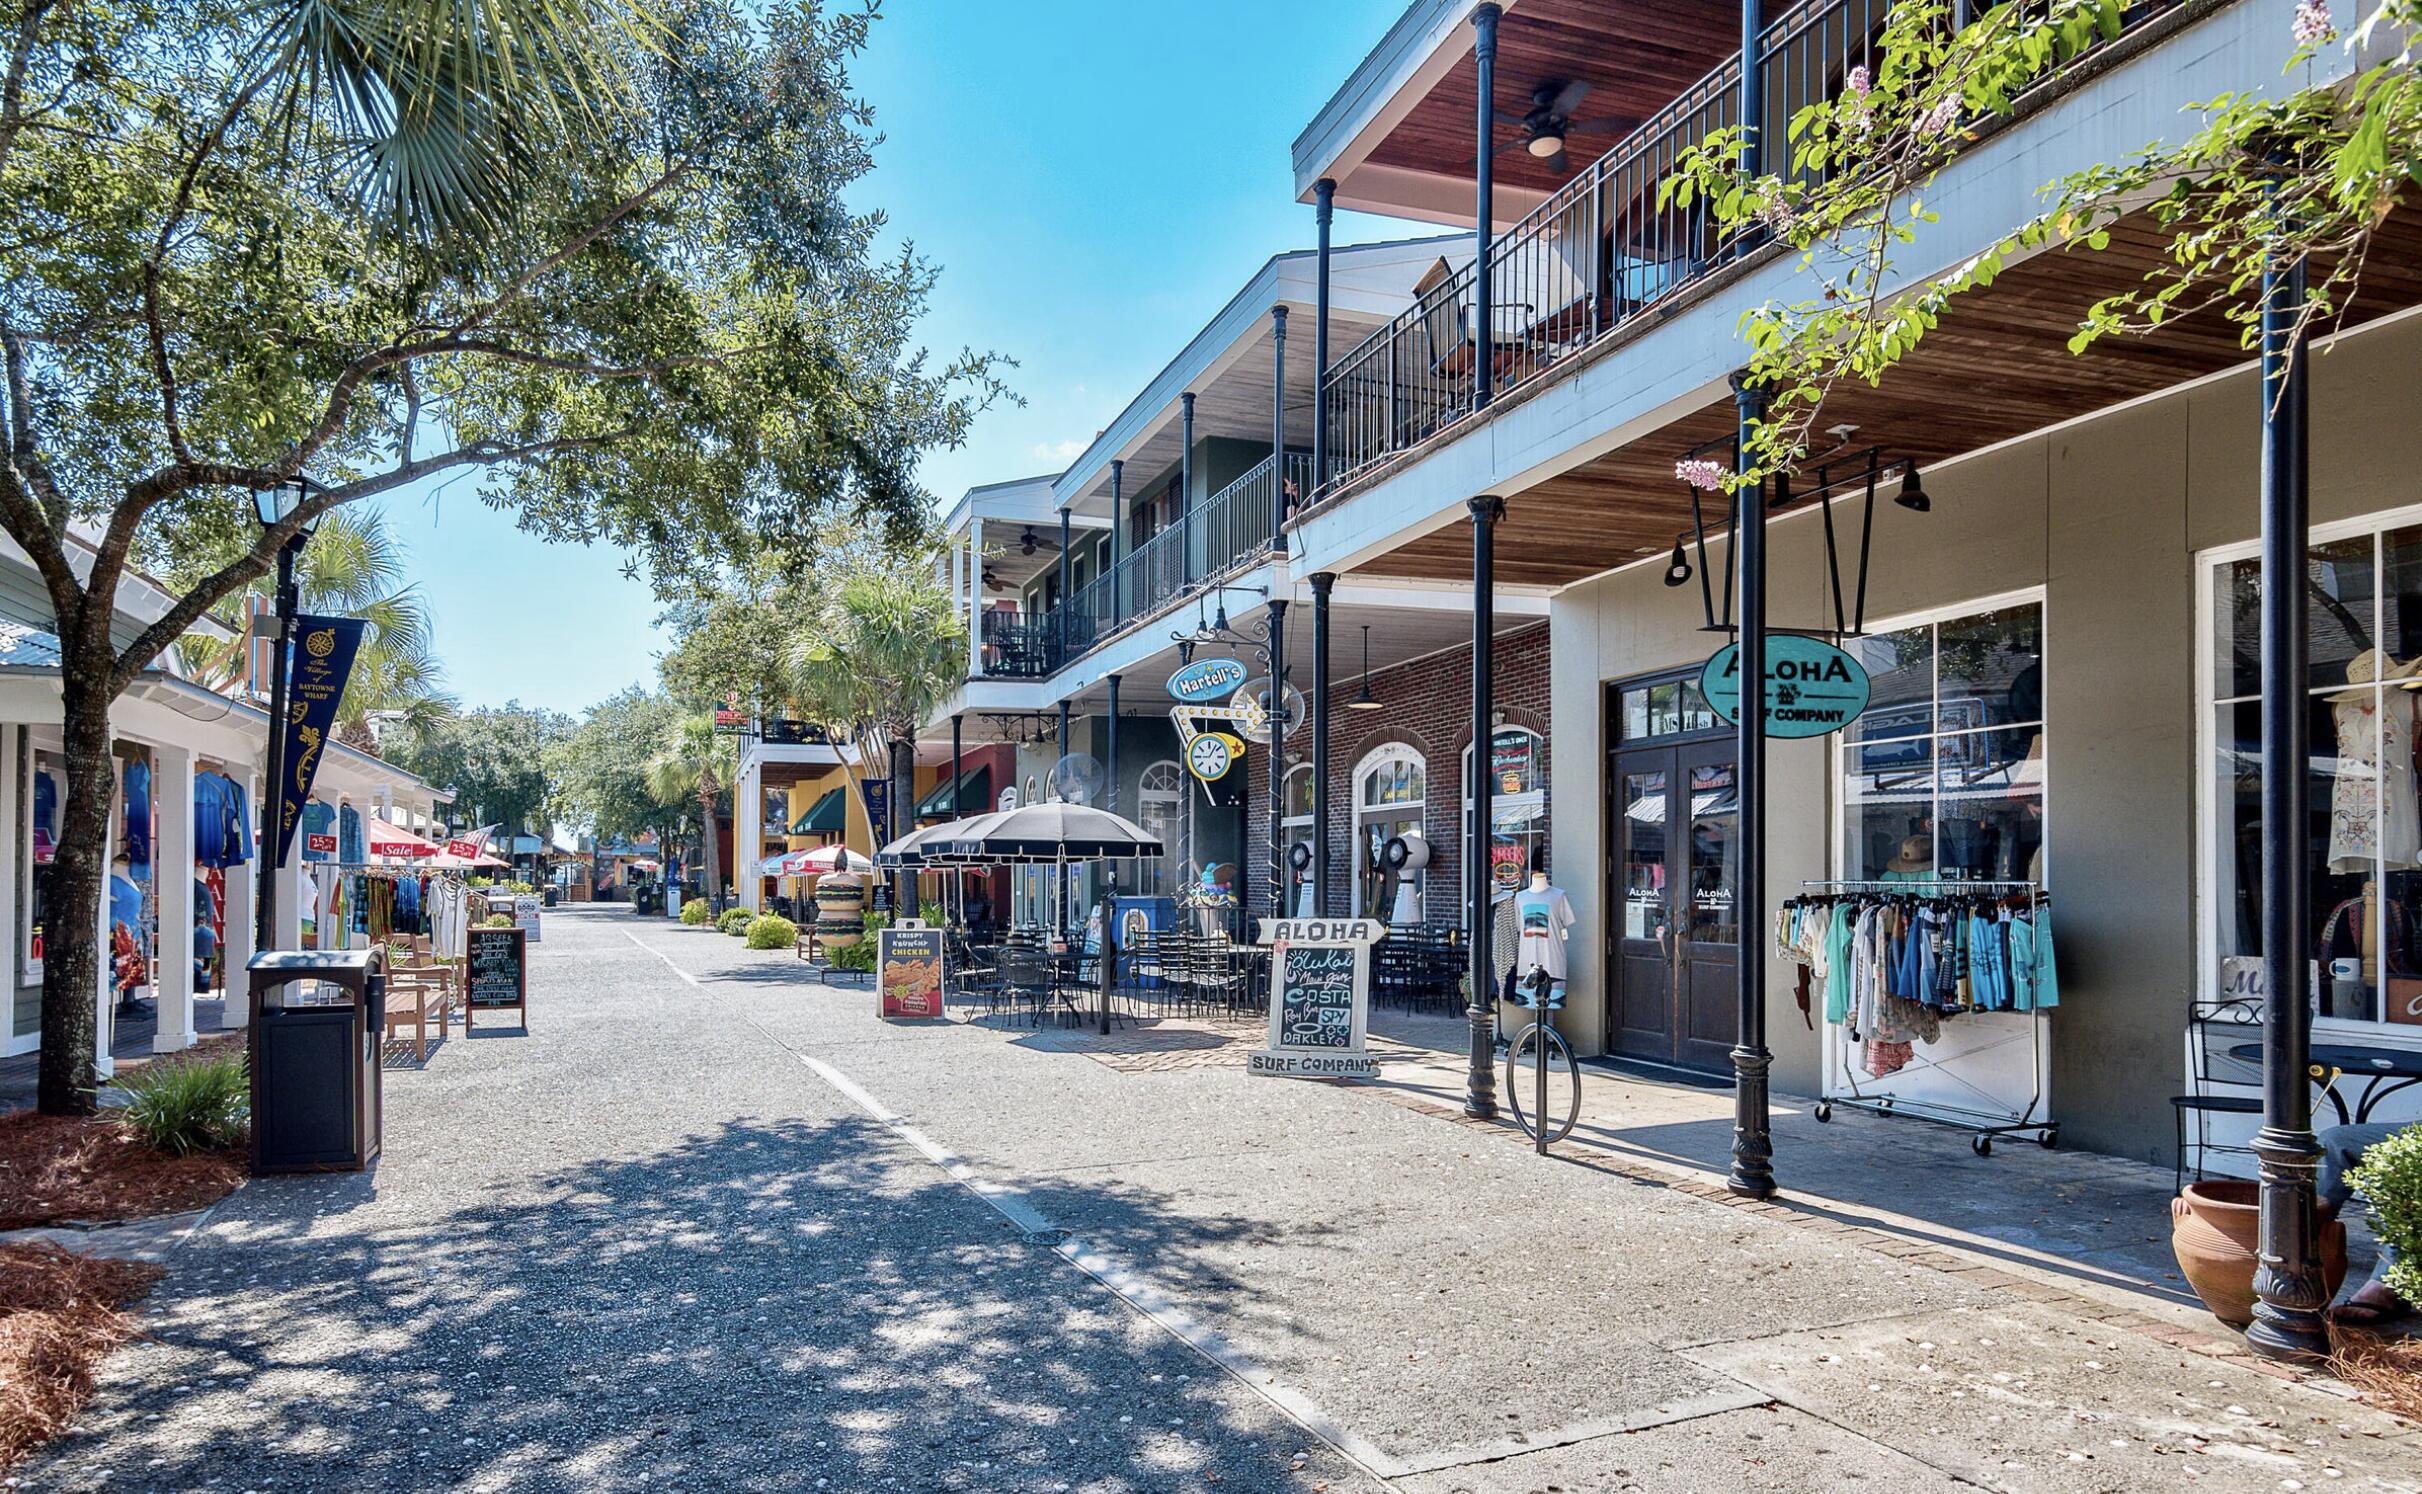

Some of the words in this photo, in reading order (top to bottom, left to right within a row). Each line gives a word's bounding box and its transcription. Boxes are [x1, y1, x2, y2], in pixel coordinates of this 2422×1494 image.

[1722, 651, 1852, 682] AOHA
[299, 683, 336, 692] BAYTOWNE
[1179, 667, 1240, 695] Hartell's
[1775, 708, 1845, 723] COMPANY
[384, 844, 412, 856] Sale
[1629, 888, 1659, 896] ALOHA
[1696, 889, 1732, 898] ALOHA
[1274, 921, 1368, 941] ALOHA
[1299, 971, 1322, 983] Maui
[1285, 988, 1352, 1004] COSTA
[1321, 1009, 1346, 1024] SPY
[1284, 1031, 1334, 1045] OAKLEY
[1253, 1055, 1297, 1071] SURF
[1302, 1057, 1372, 1073] COMPANY
